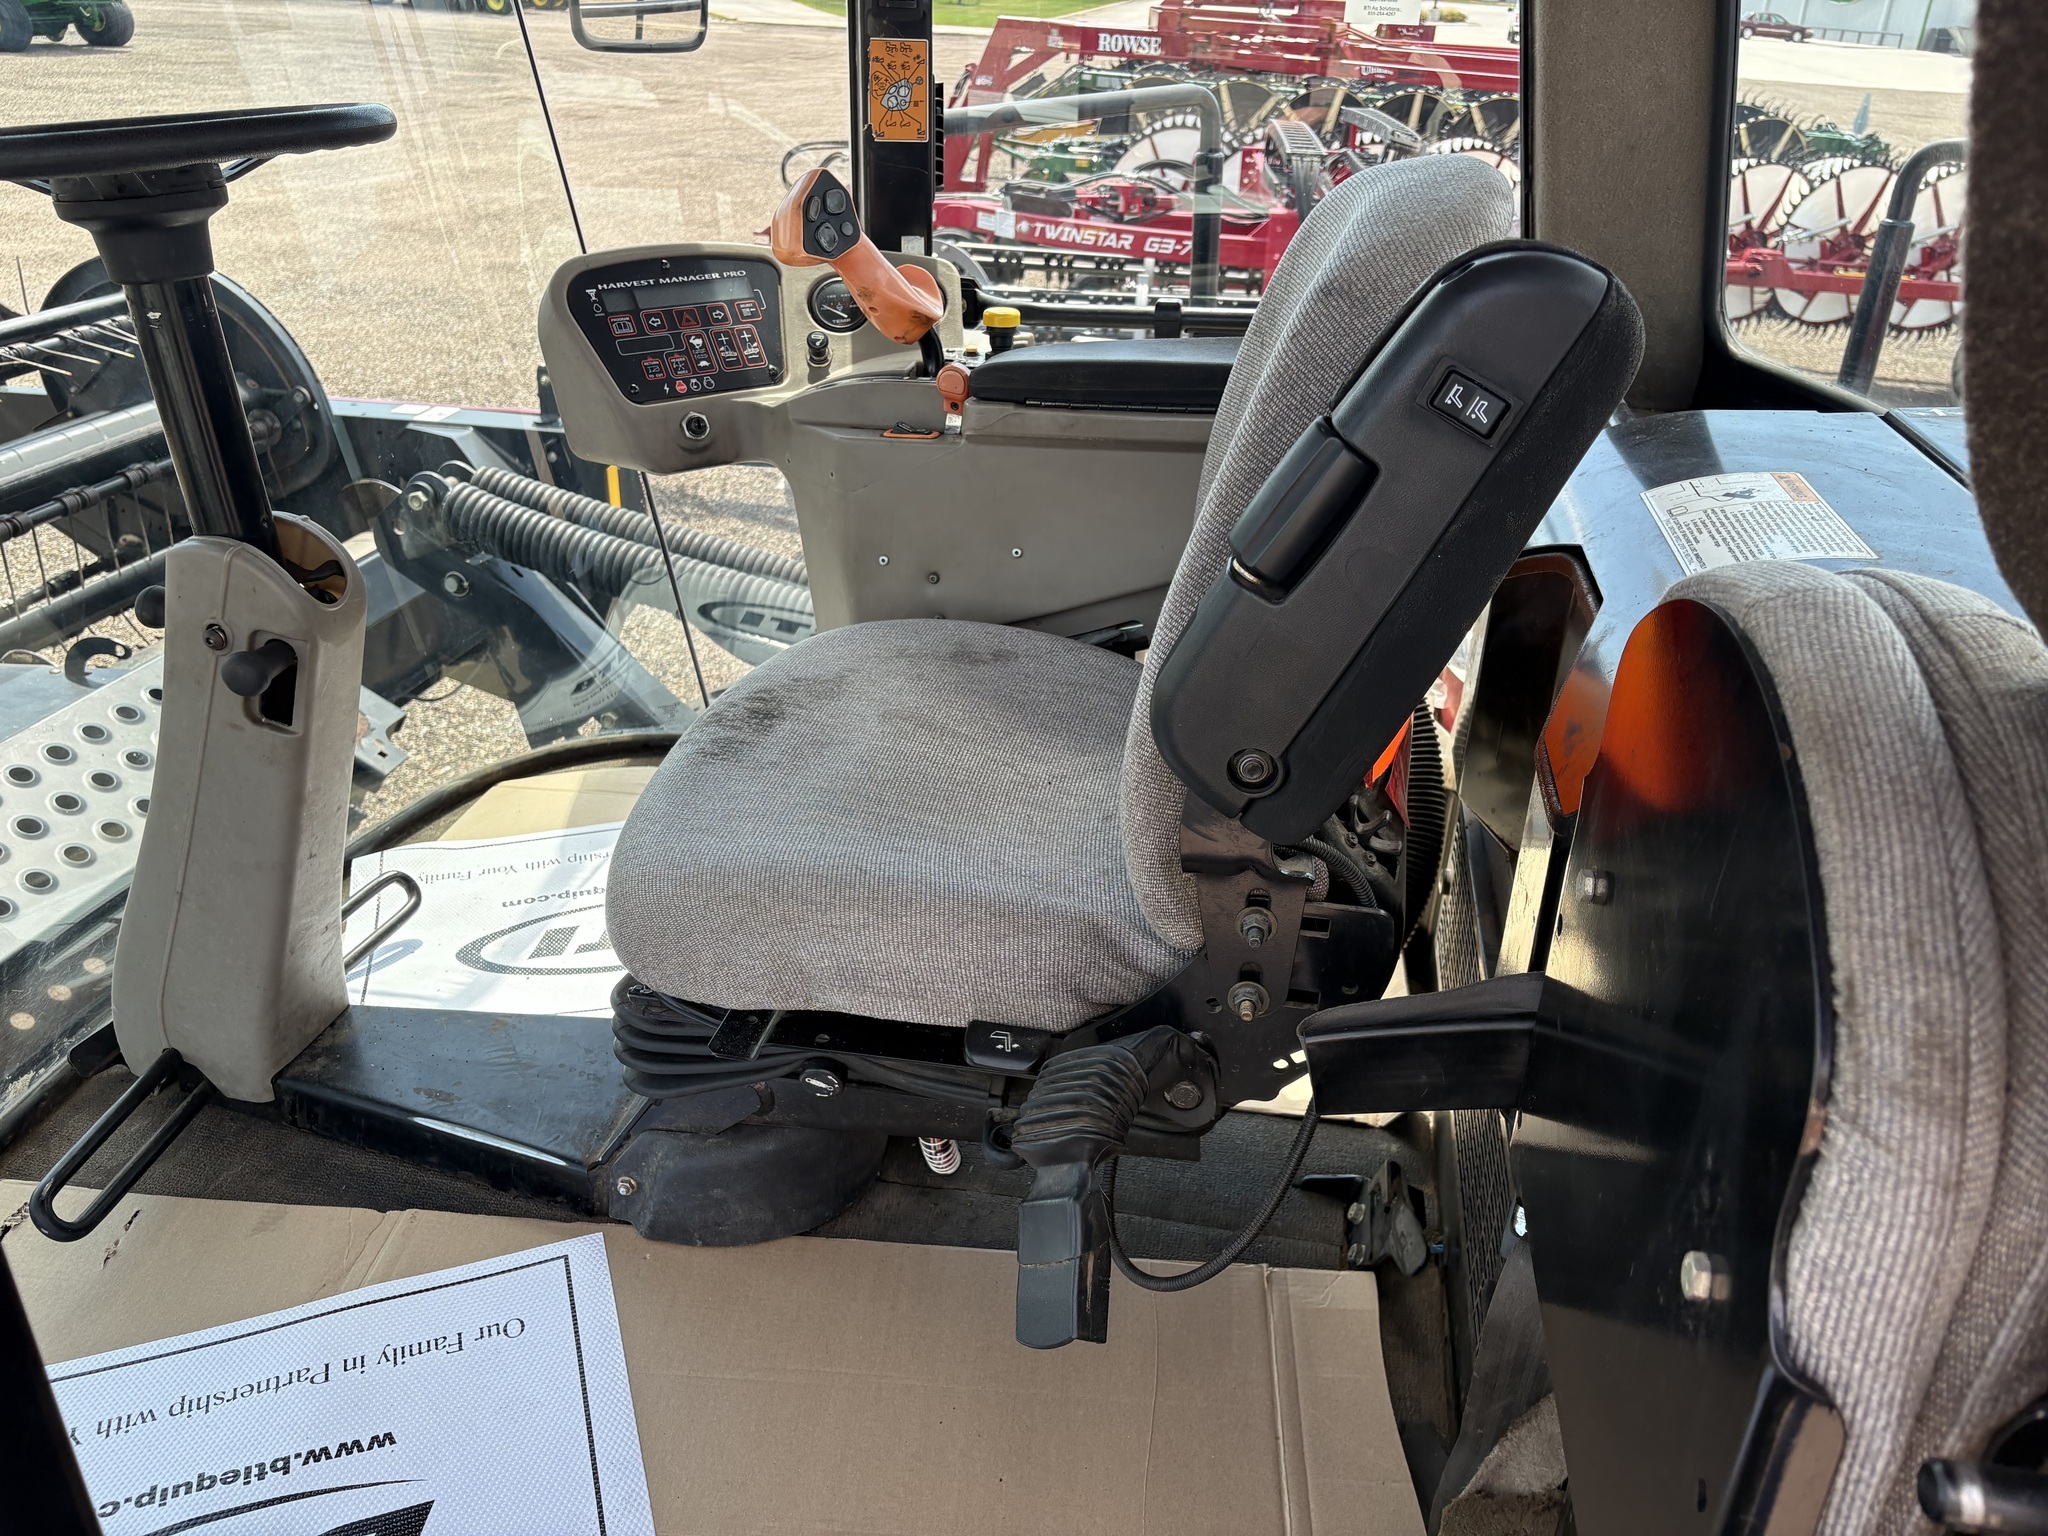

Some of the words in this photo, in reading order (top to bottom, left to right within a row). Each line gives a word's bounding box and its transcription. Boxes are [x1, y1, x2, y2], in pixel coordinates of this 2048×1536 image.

[1097, 33, 1162, 56] ROWSE
[1033, 222, 1134, 250] TWINSTAR
[597, 278, 656, 290] HARVEST
[659, 272, 722, 285] MANAGER
[723, 269, 747, 279] PRO
[478, 865, 518, 877] Your
[525, 856, 561, 871] with
[415, 870, 471, 885] Family
[474, 1317, 526, 1342] Our
[376, 1331, 465, 1368] Family
[343, 1354, 366, 1375] in
[168, 1362, 331, 1419] Partnership
[96, 1408, 158, 1440] with
